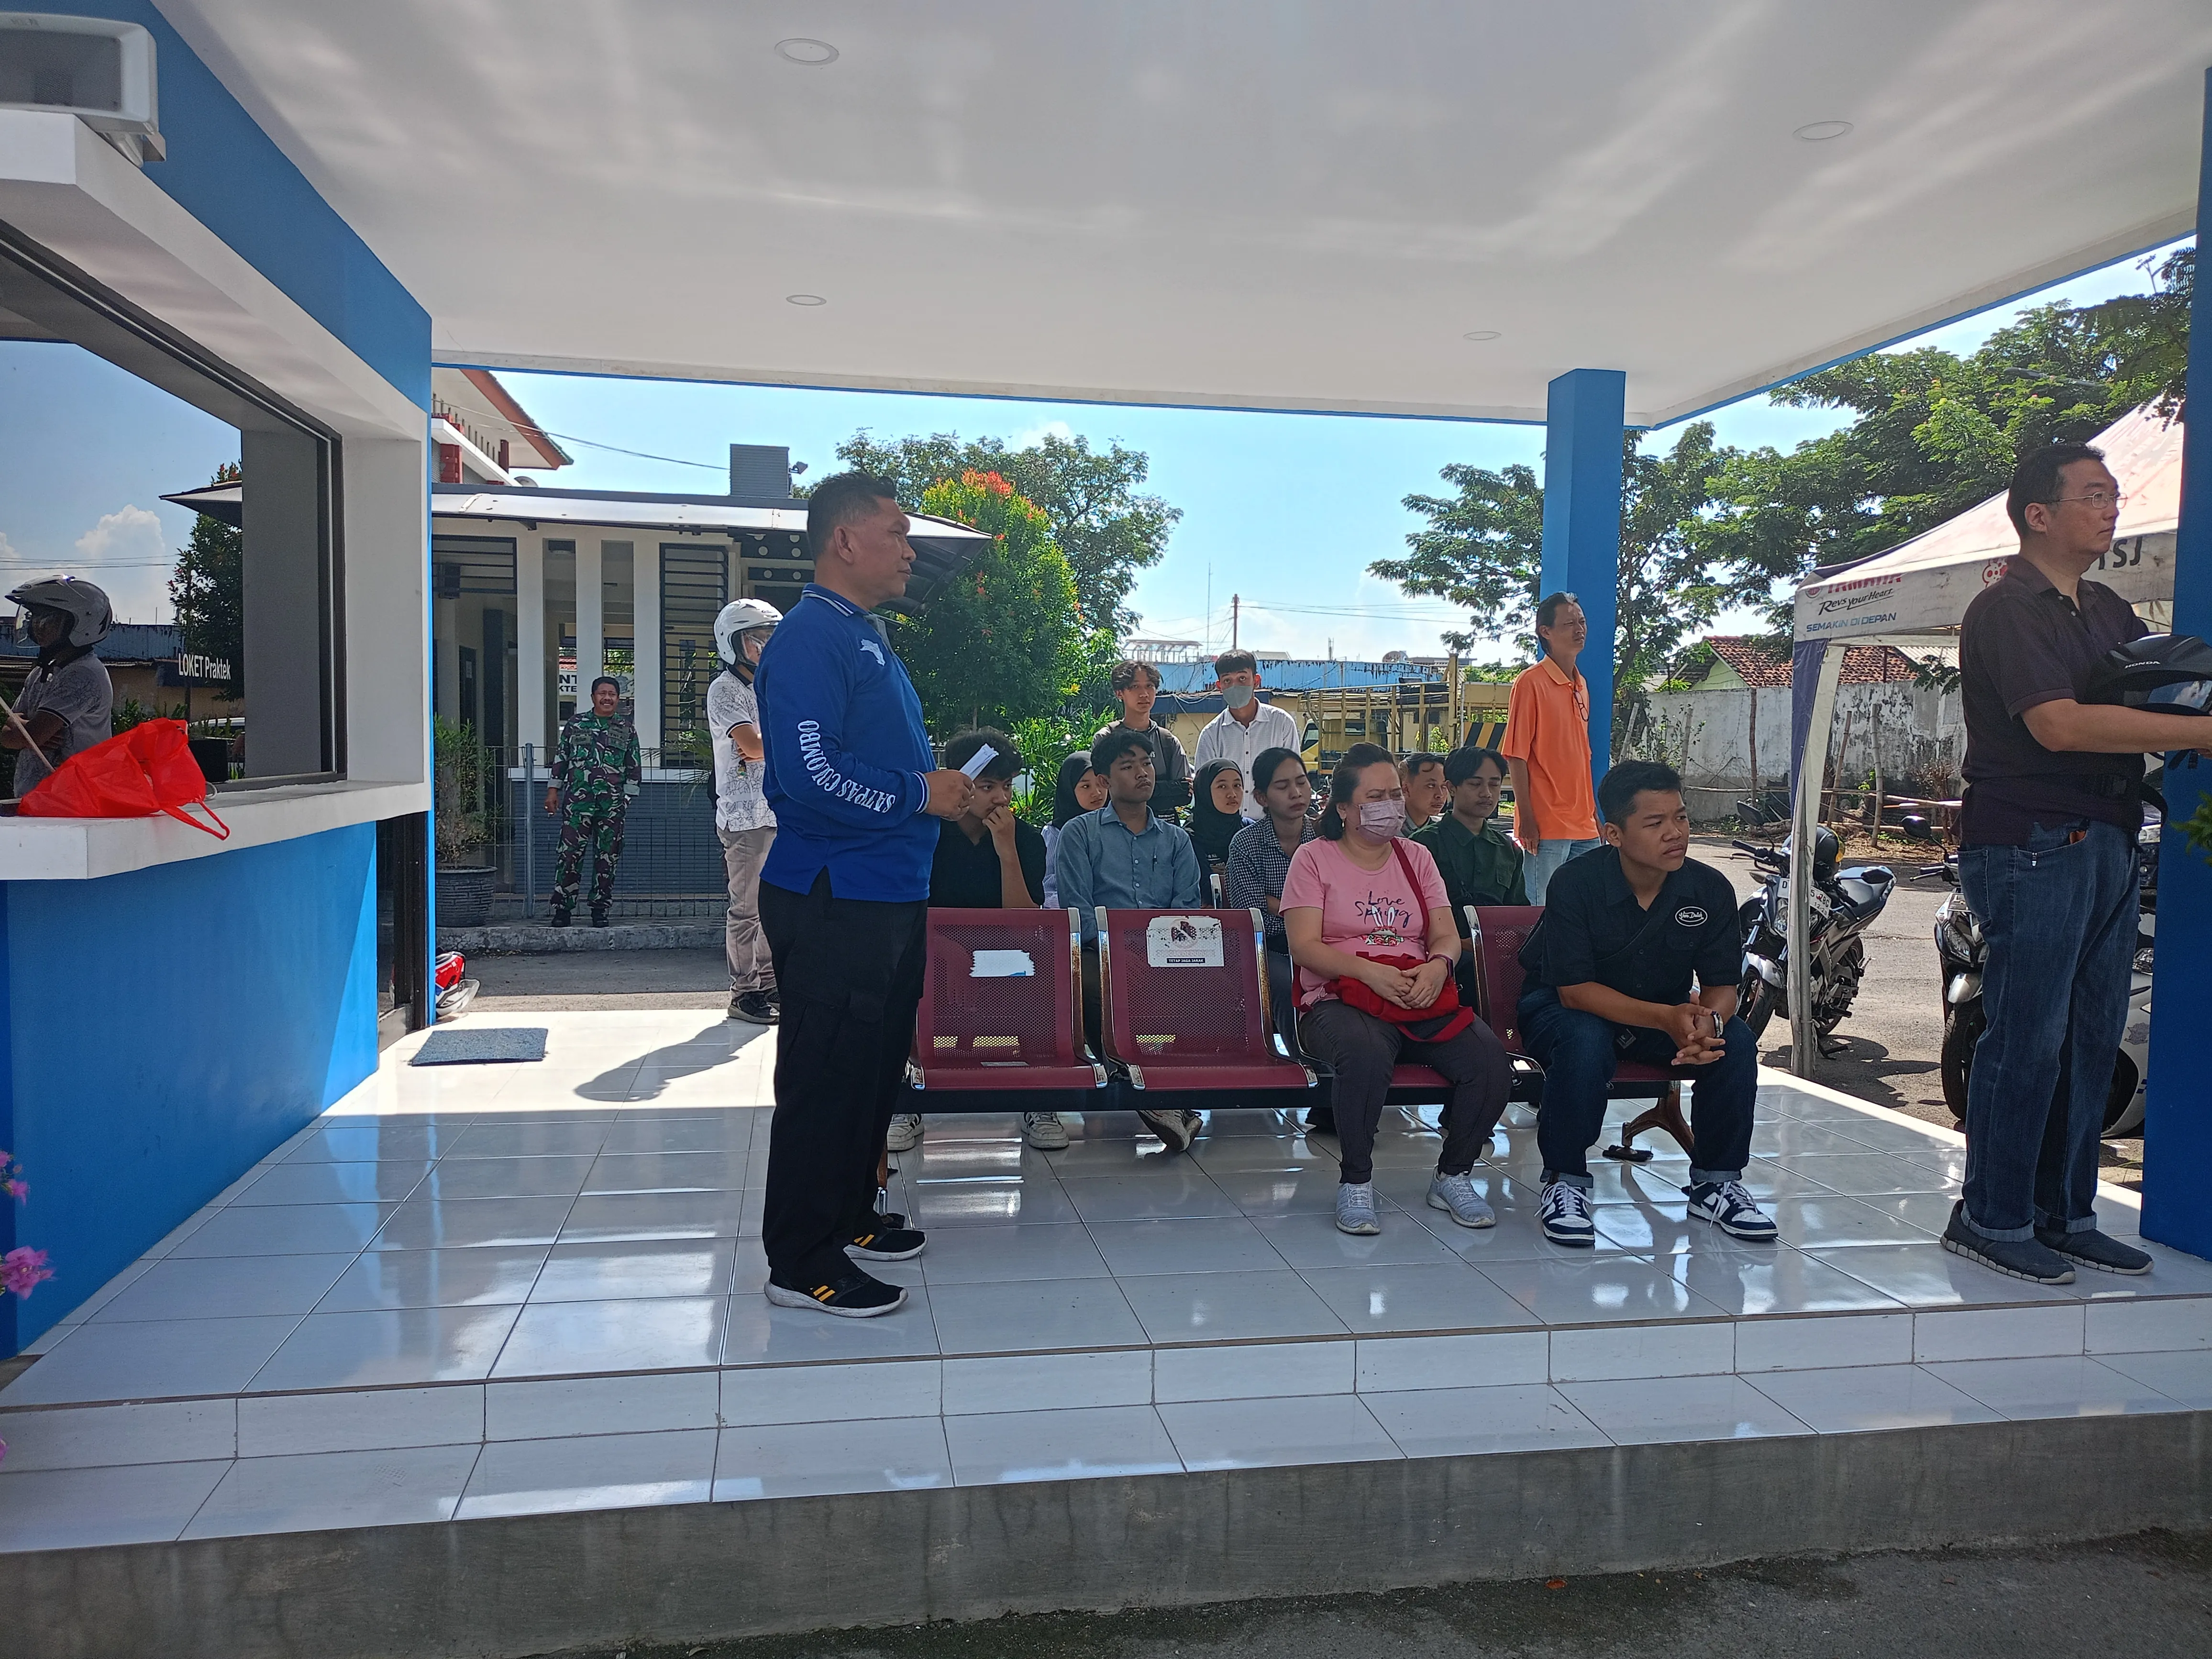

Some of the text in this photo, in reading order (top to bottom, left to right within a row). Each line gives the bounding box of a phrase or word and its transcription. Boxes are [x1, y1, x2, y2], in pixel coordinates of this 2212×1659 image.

[1818, 598, 1847, 616] Revs
[1861, 612, 1897, 625] DEPAN
[178, 653, 231, 680] LOKET Praktek
[2124, 661, 2161, 669] HONDA
[797, 720, 896, 813] SATPAS COLOMBO
[1368, 890, 1405, 906] Love
